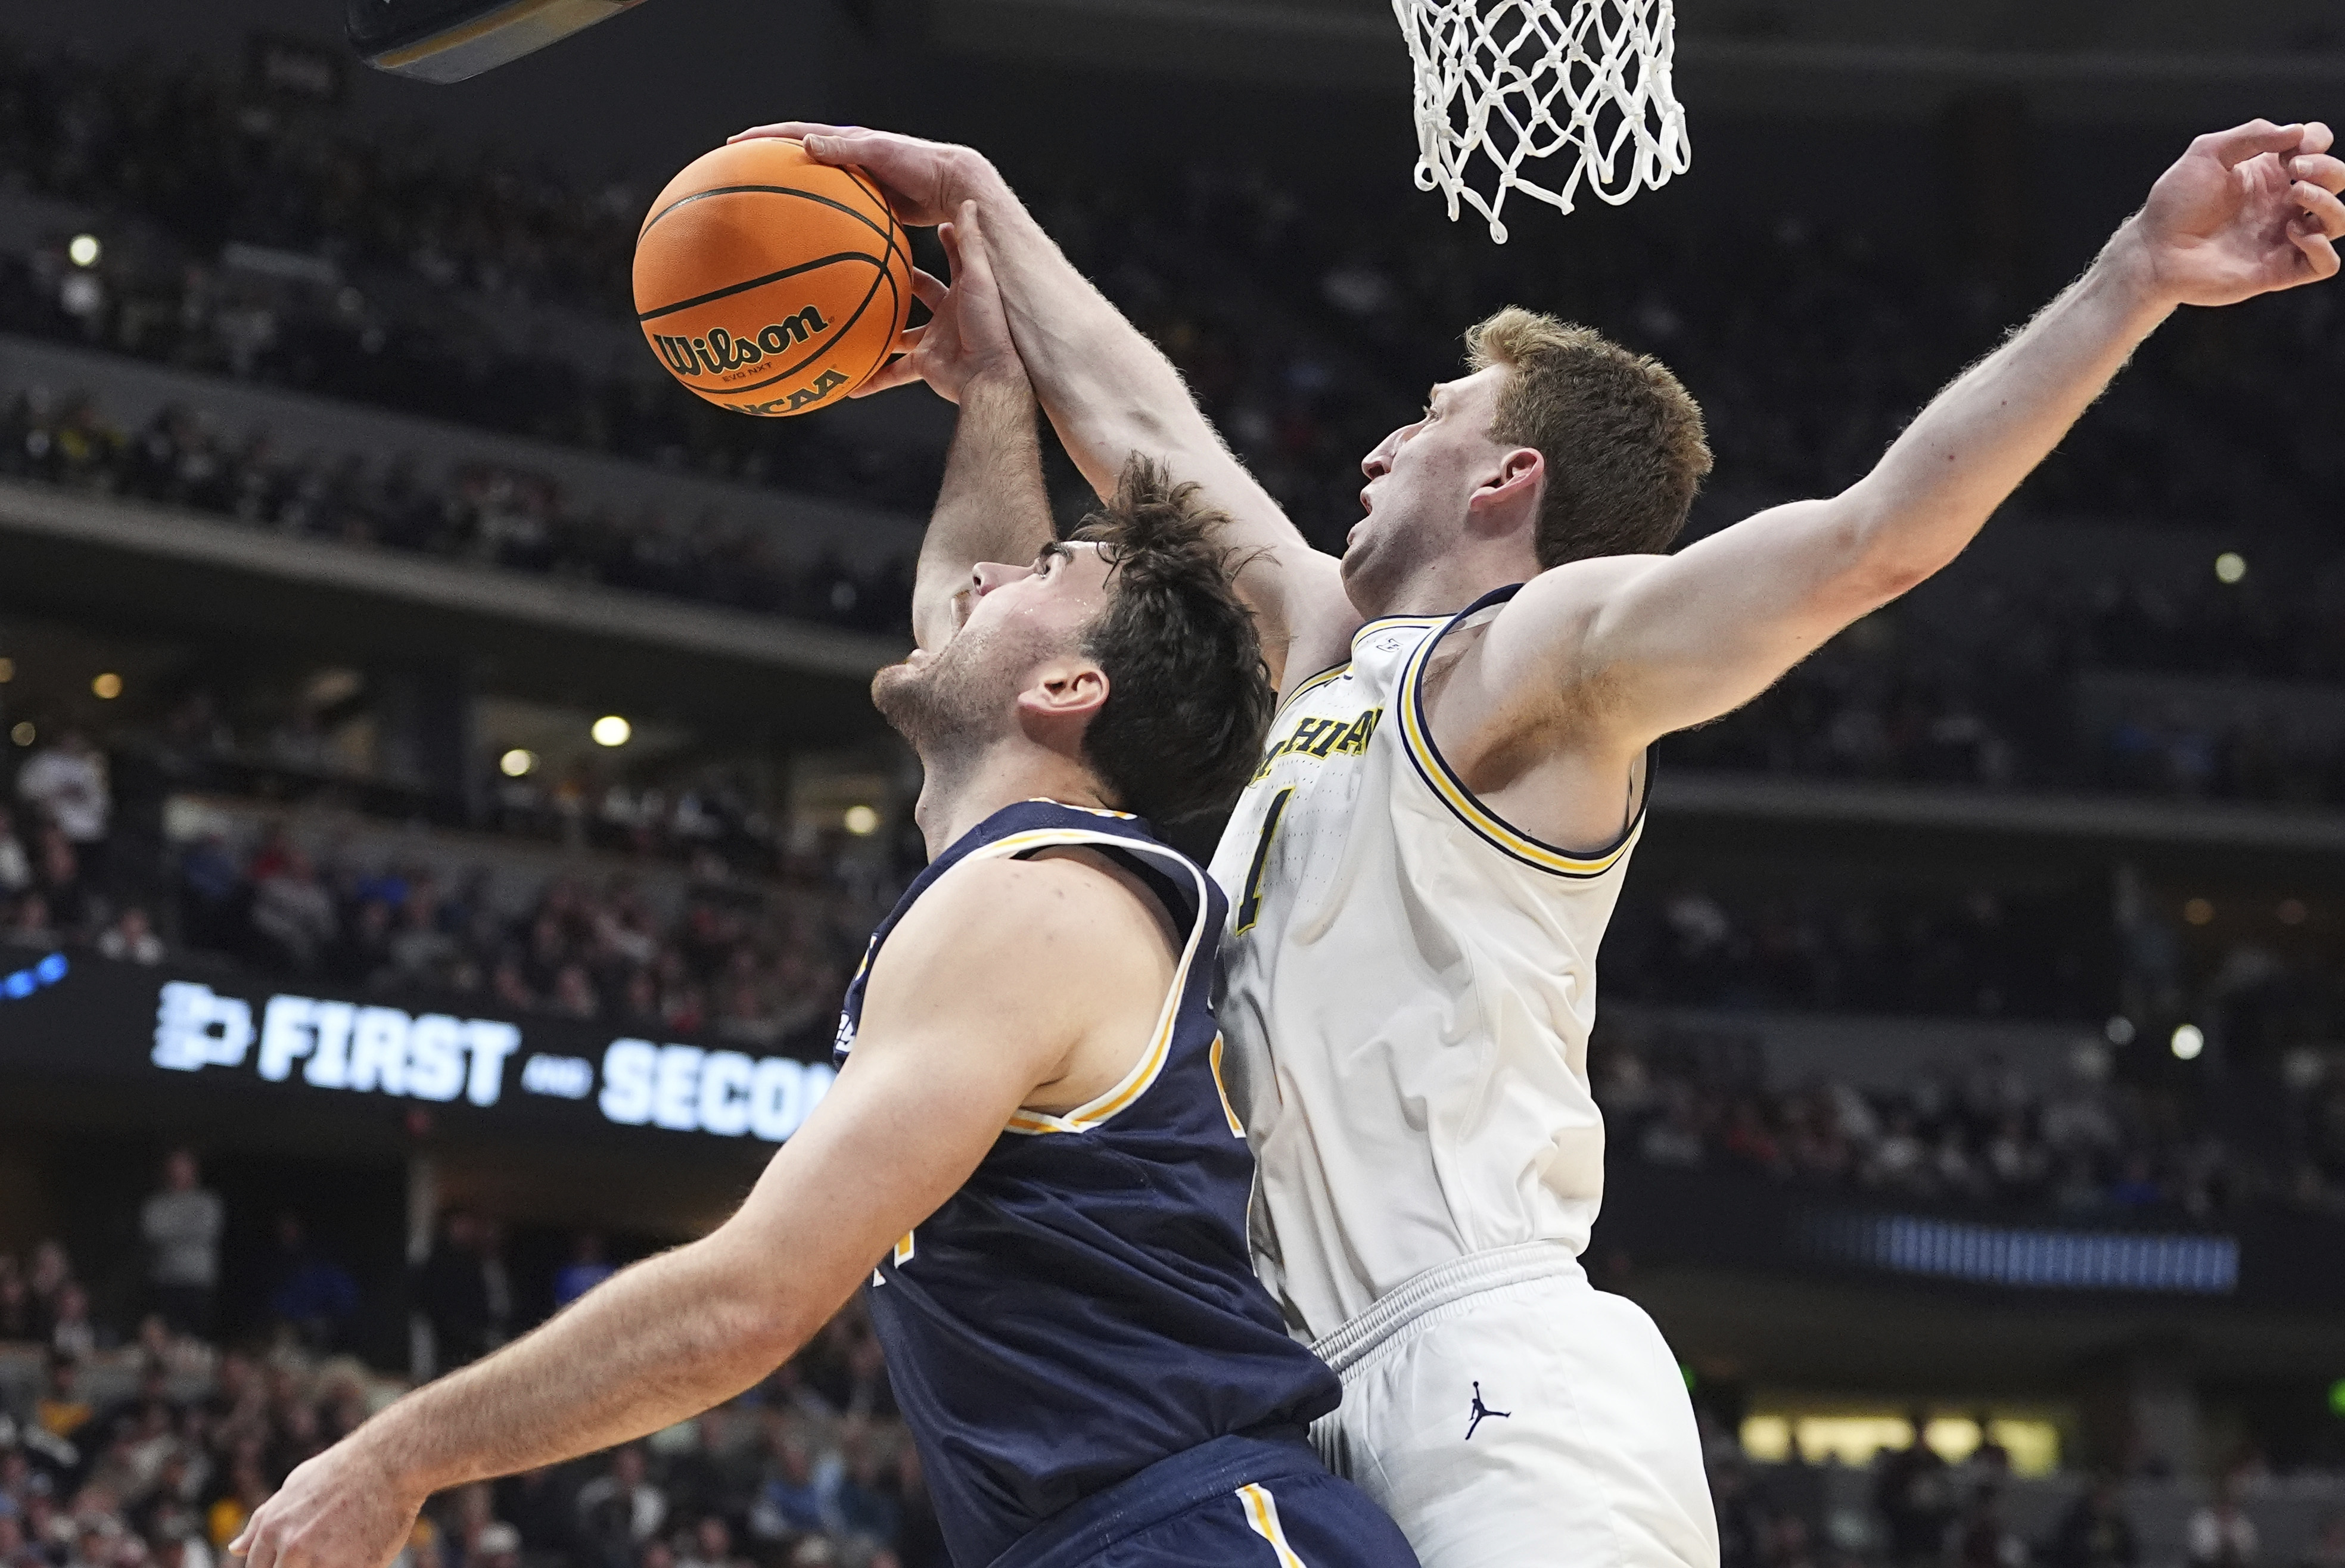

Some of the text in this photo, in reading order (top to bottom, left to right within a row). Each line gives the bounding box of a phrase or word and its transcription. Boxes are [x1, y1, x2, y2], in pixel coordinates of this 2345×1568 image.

[653, 304, 829, 376] Wilson
[748, 362, 772, 375] NXT
[1237, 785, 1296, 937] 1
[258, 994, 522, 1107] FIRST
